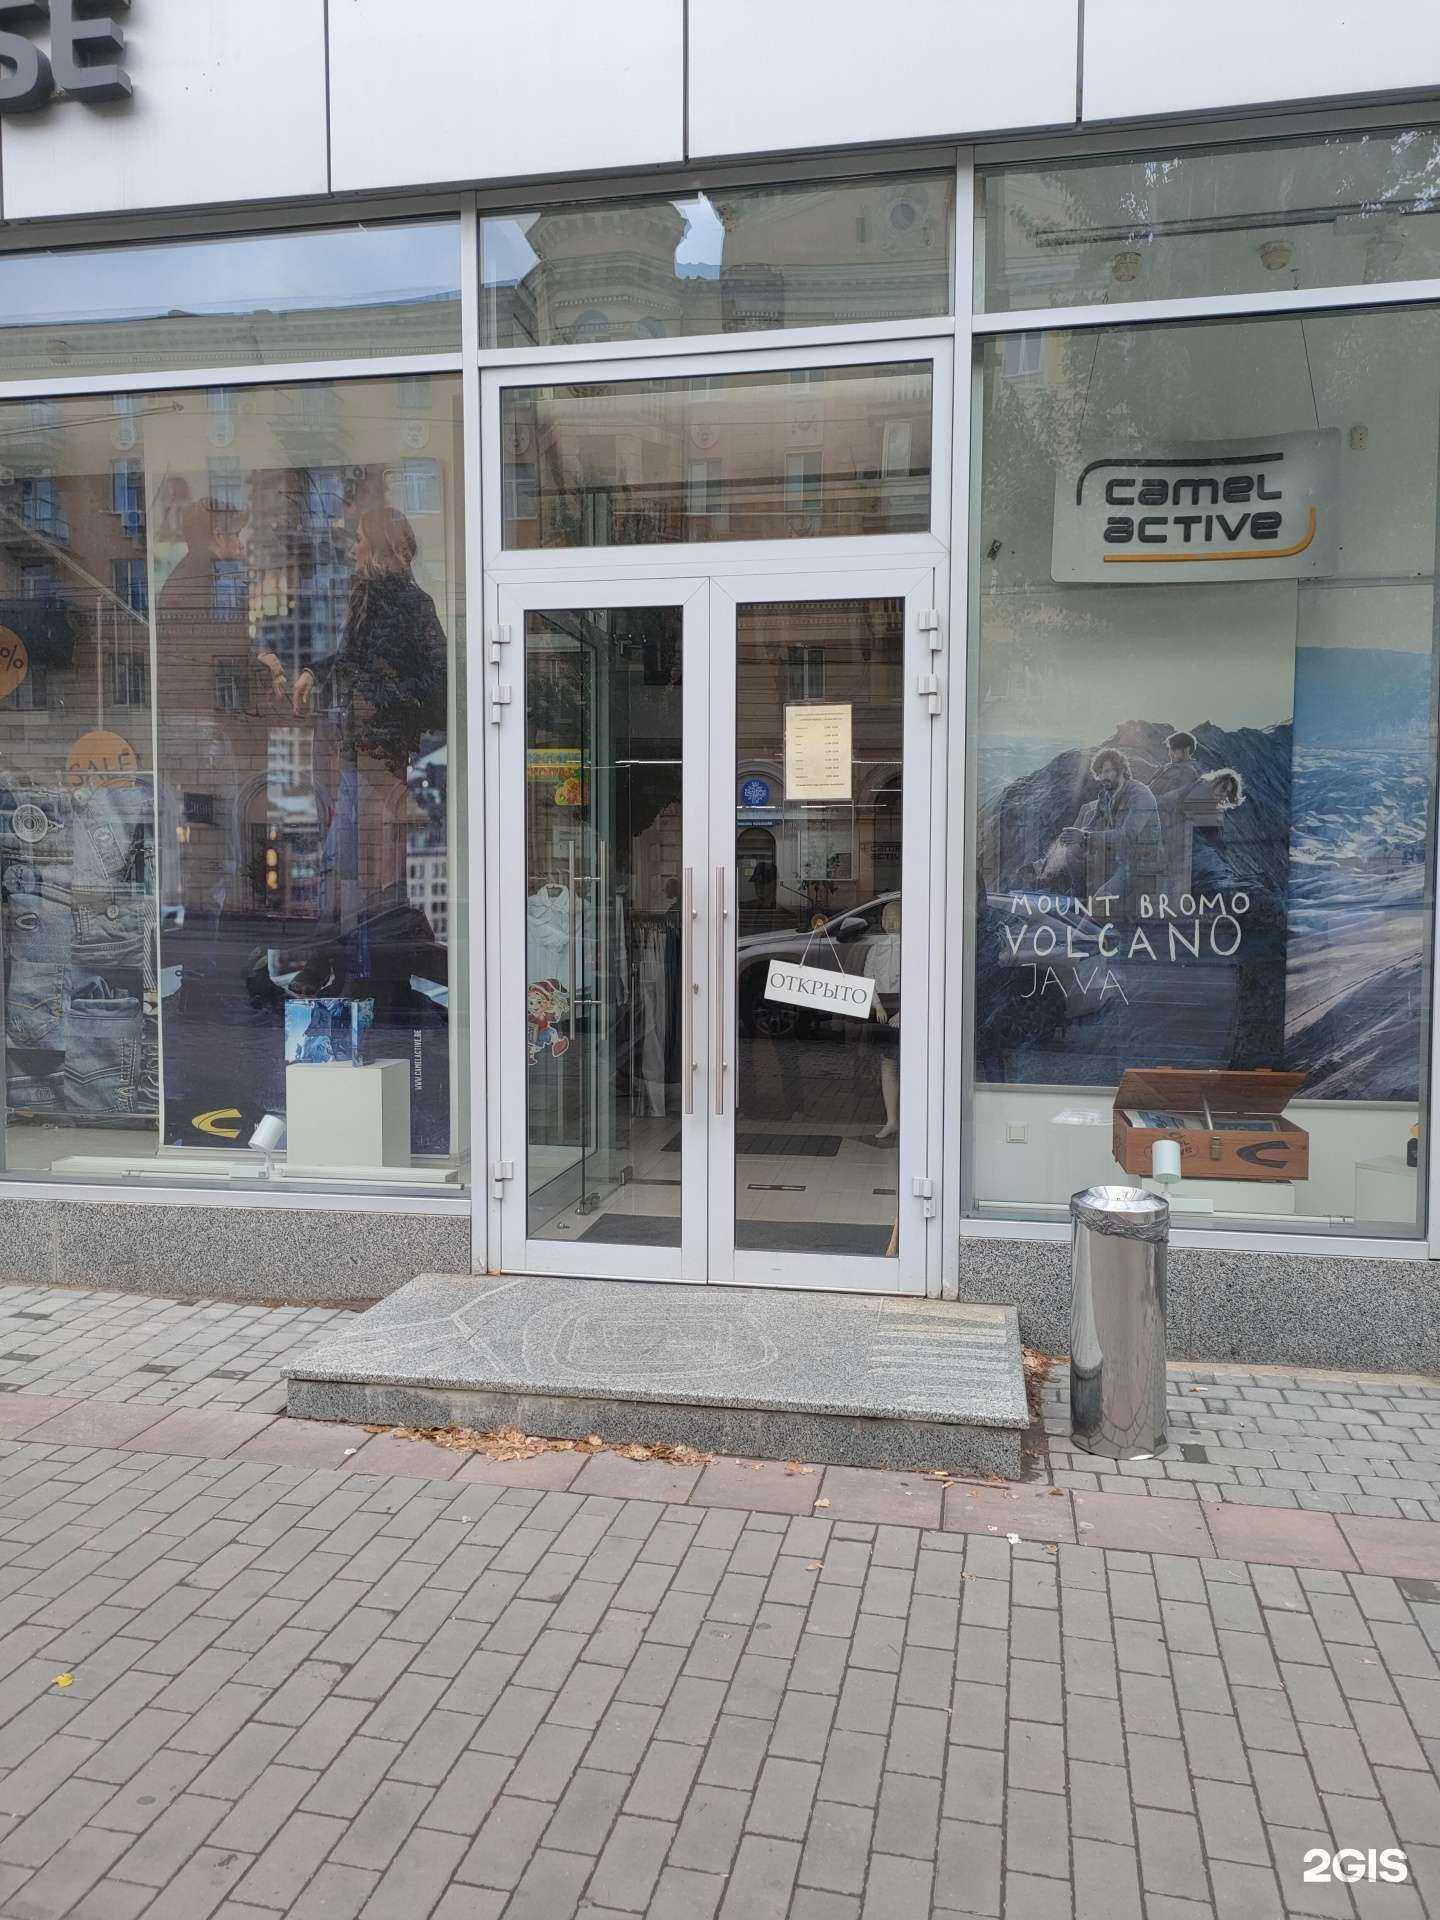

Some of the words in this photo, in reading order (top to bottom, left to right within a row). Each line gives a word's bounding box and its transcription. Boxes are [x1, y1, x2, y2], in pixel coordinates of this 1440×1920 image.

[1010, 894, 1120, 918] MOUNT
[1140, 891, 1251, 919] BROMO
[1004, 914, 1242, 962] VOLCANO
[769, 972, 868, 1006] ОТКРЫТО
[1020, 962, 1130, 1005] JAVA
